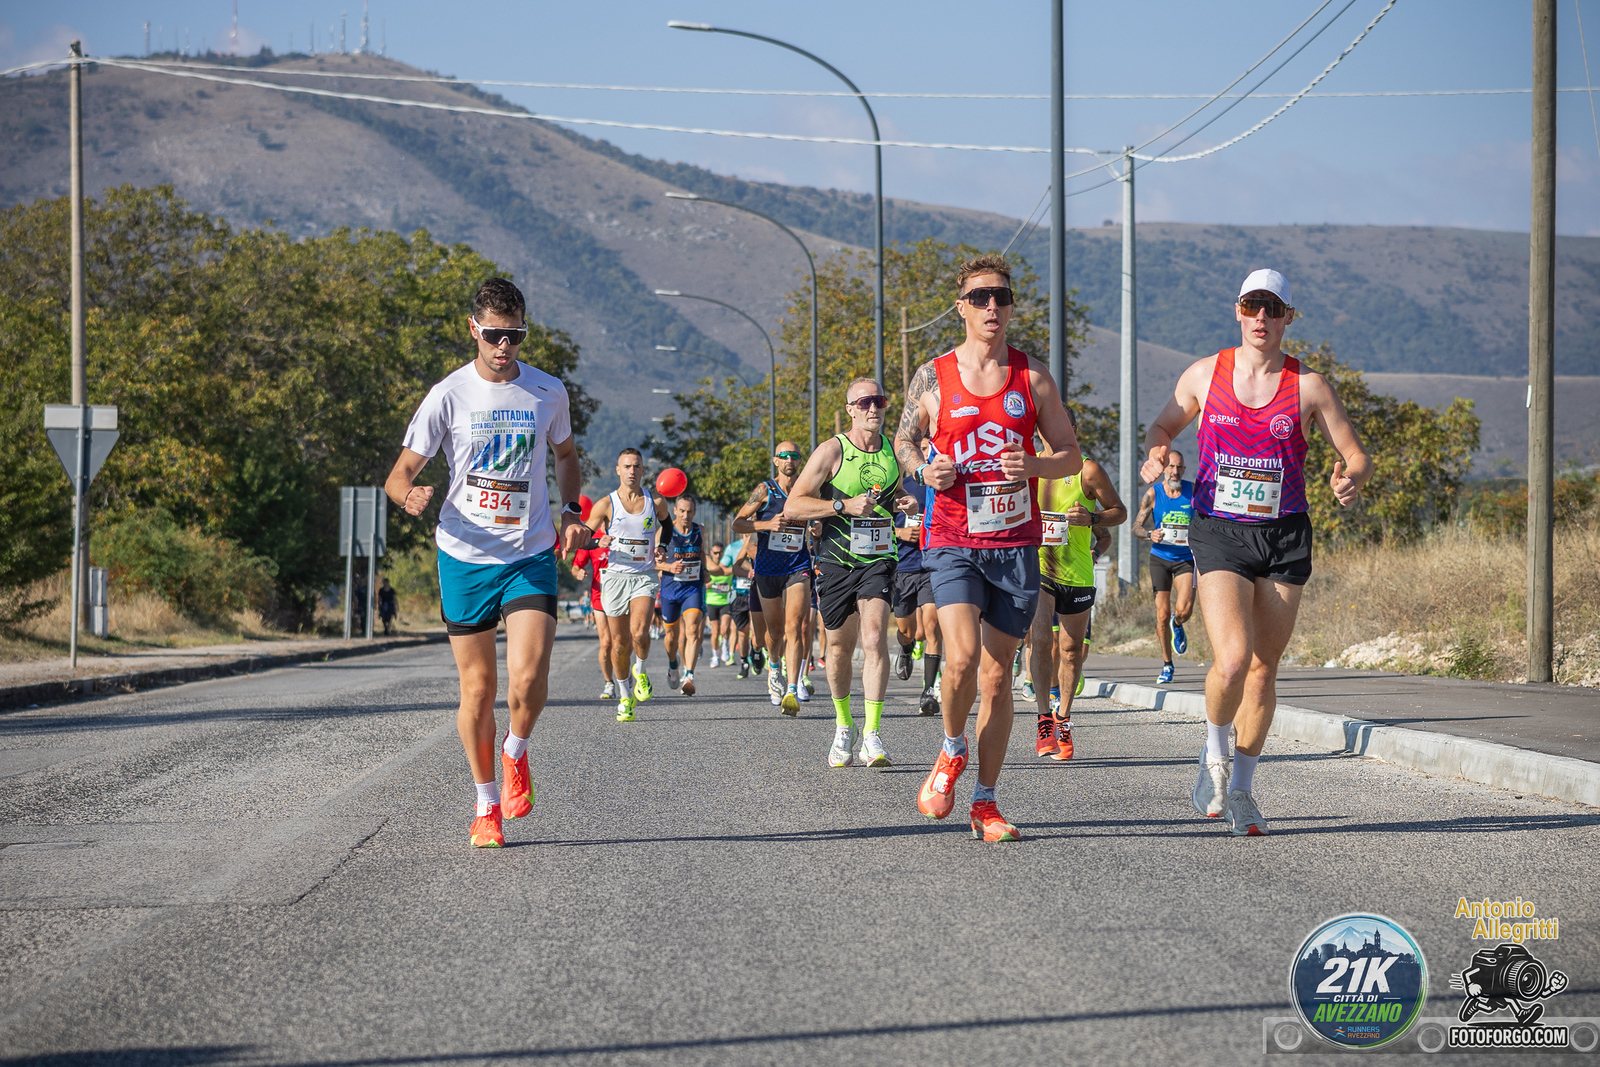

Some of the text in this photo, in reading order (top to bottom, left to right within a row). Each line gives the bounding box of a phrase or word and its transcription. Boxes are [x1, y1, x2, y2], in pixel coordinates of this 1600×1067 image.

[1216, 414, 1240, 425] SPMC
[471, 434, 536, 476] RUN
[1215, 452, 1283, 469] POLISPORTIVA
[1229, 468, 1246, 478] 5K
[477, 478, 494, 488] 10K
[981, 486, 998, 495] 10K
[1231, 480, 1265, 502] 346
[479, 490, 511, 511] 234
[990, 495, 1016, 514] 166
[781, 533, 793, 543] 29
[870, 529, 880, 542] 13
[1173, 530, 1178, 538] 3
[630, 546, 636, 554] 4
